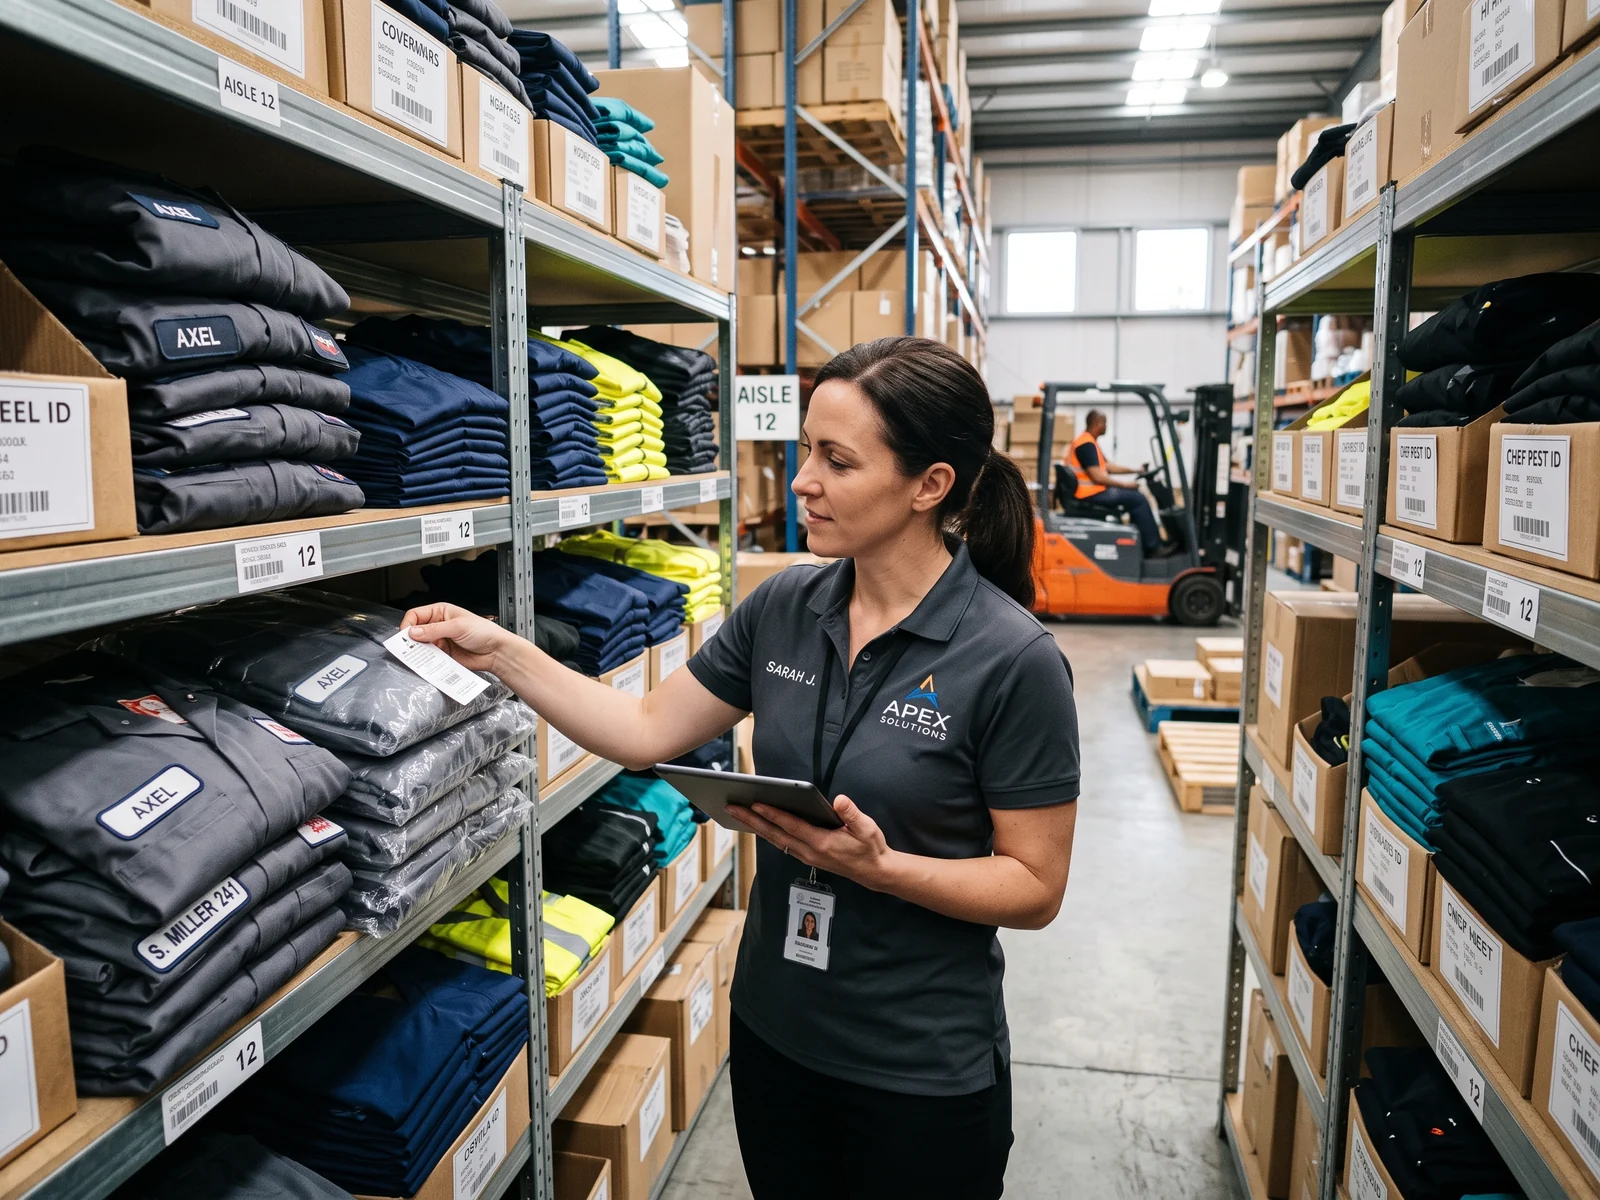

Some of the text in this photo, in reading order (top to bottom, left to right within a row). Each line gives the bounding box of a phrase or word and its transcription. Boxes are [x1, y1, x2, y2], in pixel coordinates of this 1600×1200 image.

[224, 75, 276, 111] AISLE 12
[153, 202, 202, 221] AXEL
[177, 326, 221, 349] AXEL
[737, 385, 792, 404] AISLE
[0, 400, 71, 423] EEL ID
[754, 412, 776, 431] 12
[1425, 446, 1432, 460] ID
[1506, 448, 1562, 468] CHEF PEST ID
[581, 502, 588, 516] 12
[459, 521, 470, 539] 12
[298, 544, 316, 568] 12
[1414, 558, 1423, 578] 12
[1520, 597, 1533, 622] 12
[316, 666, 350, 690] AXEL
[766, 660, 816, 687] SARAH J.
[882, 699, 952, 731] APEX
[879, 714, 947, 742] SOLUTIONS
[131, 786, 178, 820] AXEL
[148, 880, 241, 961] S. MILLER 241
[236, 1041, 258, 1072] 12
[1568, 1033, 1600, 1077] CHEF
[1469, 1077, 1481, 1108] 12
